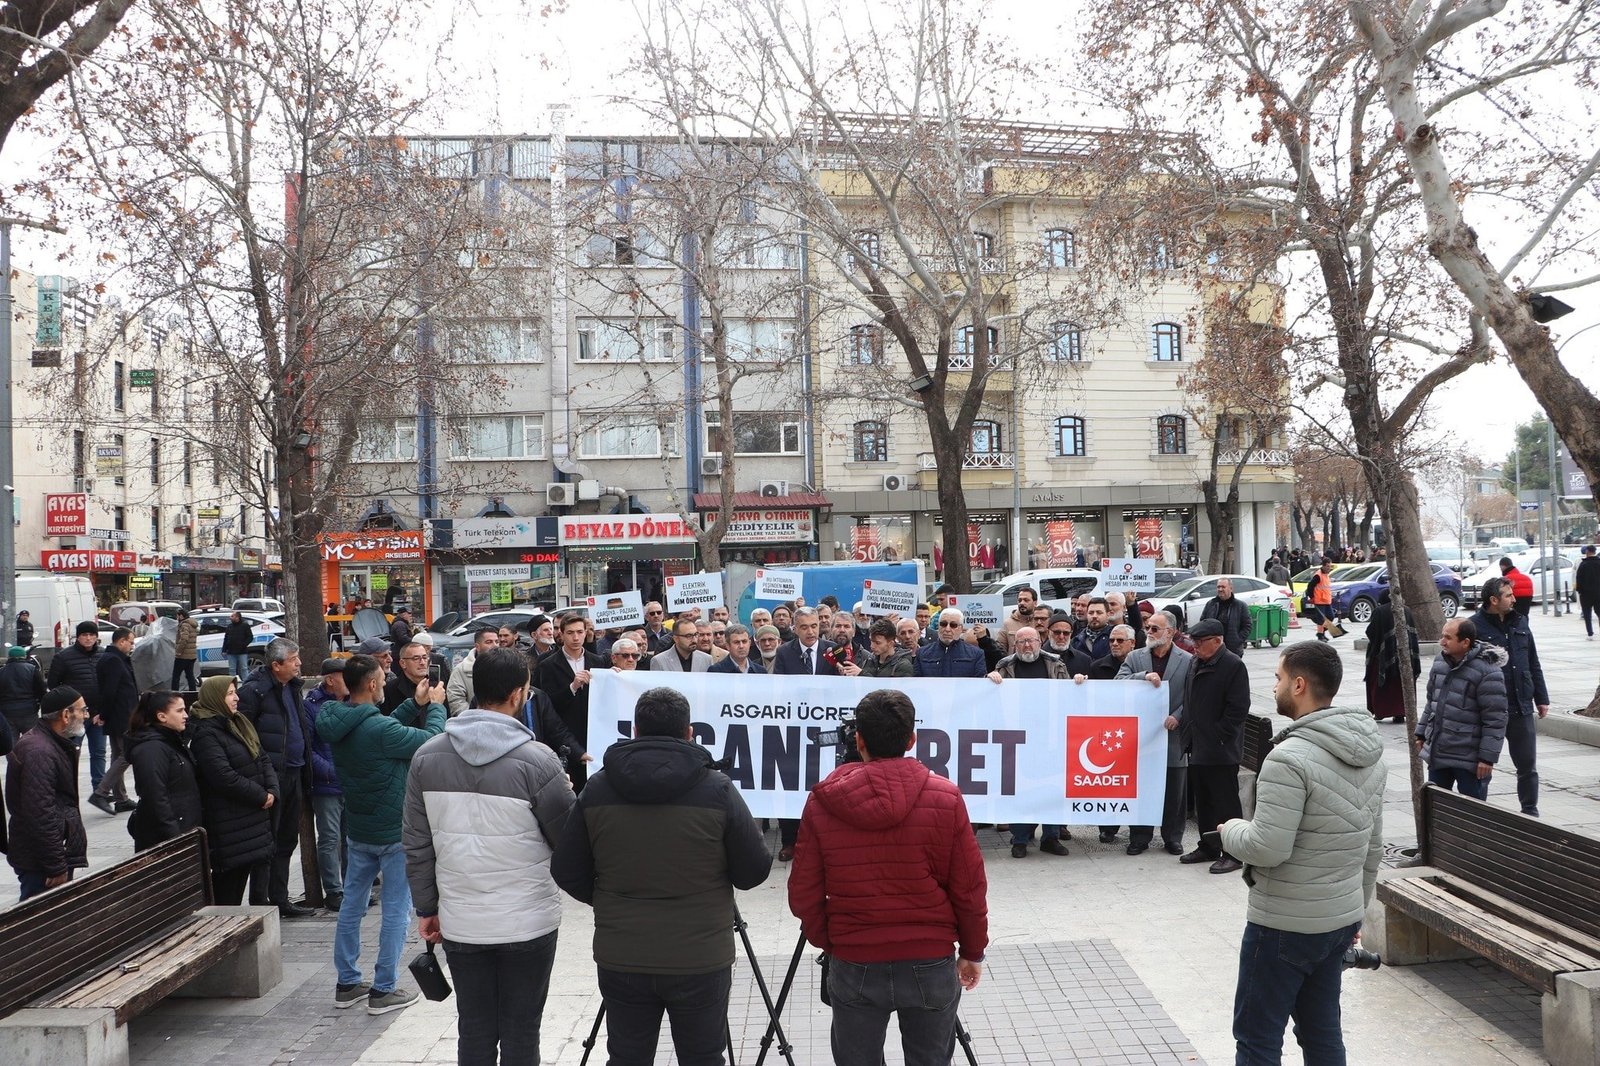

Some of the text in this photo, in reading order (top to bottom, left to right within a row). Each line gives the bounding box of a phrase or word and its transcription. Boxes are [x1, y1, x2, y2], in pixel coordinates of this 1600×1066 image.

[48, 496, 85, 512] AYAS
[765, 511, 810, 520] OTANTİK
[47, 525, 85, 533] KIRTASİYE
[464, 528, 517, 537] Türk Telekom
[564, 517, 695, 539] BEYAZ DÖNER
[1053, 539, 1073, 556] 50
[1141, 536, 1160, 552] 50
[48, 553, 88, 569] AYAS
[94, 553, 115, 568] AYAS
[492, 568, 507, 576] SATIŞ
[1119, 574, 1129, 582] ÇAY
[682, 581, 706, 590] ELEKTRİK
[680, 588, 709, 597] FATURASINI
[674, 595, 717, 605] KİM ÖDEYECEK?
[619, 607, 637, 615] PAZARA
[596, 616, 611, 624] NASIL
[720, 702, 791, 719] ASGARİ
[1074, 775, 1129, 786] SAADET
[1072, 802, 1129, 812] KONYA
